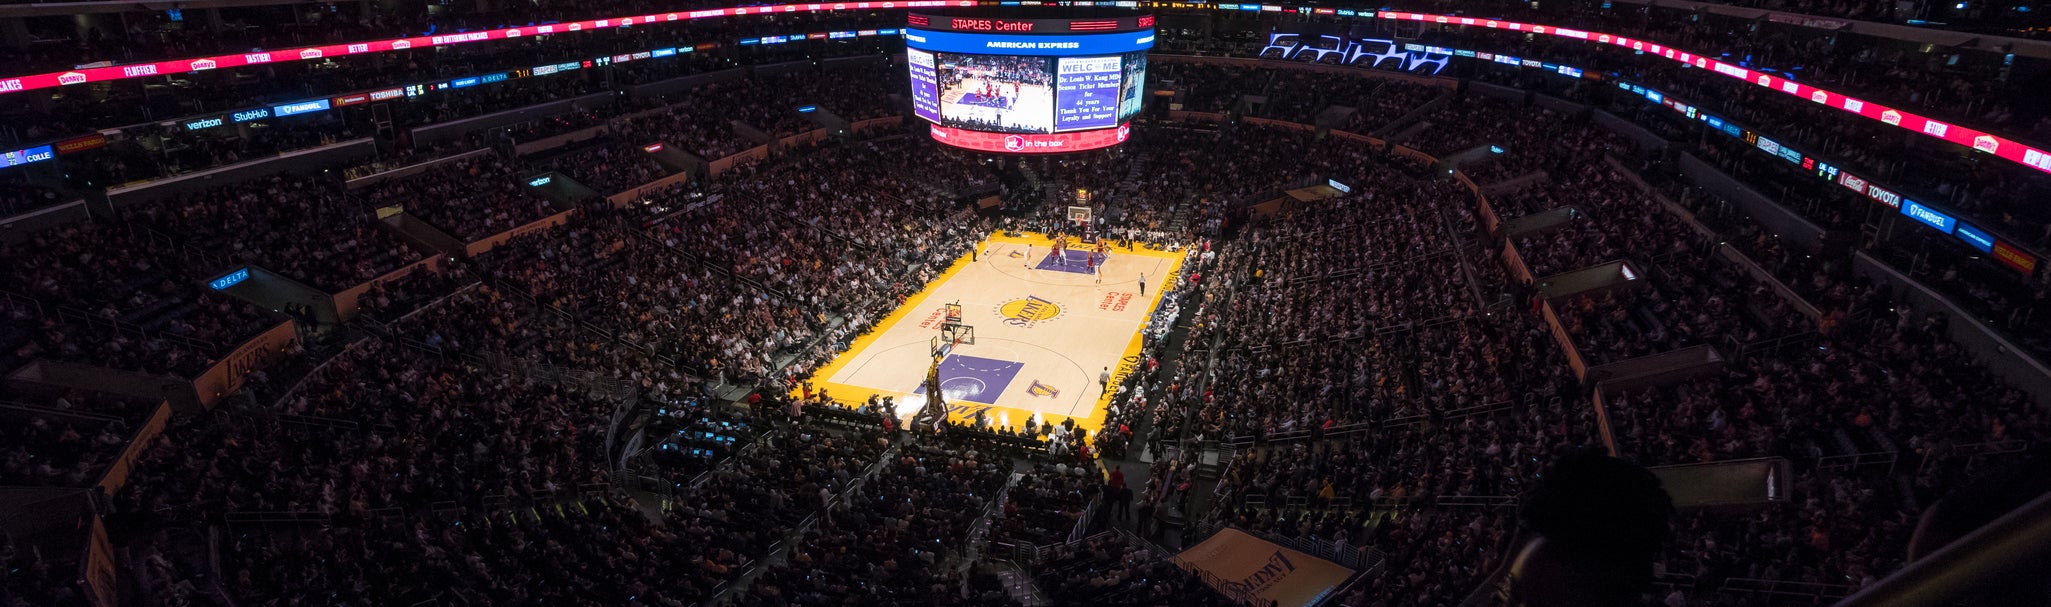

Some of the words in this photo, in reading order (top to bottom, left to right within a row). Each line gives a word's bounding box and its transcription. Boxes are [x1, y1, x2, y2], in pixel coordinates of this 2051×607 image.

[951, 18, 992, 31] STAPLES
[995, 20, 1034, 31] Center
[245, 53, 272, 64] TASTIER!
[632, 51, 651, 60] TOYOTA
[1062, 62, 1118, 72] WELCME
[1522, 59, 1542, 68] TOYOTA
[123, 64, 158, 77] FLUFFIER!
[487, 73, 508, 82] DELTA
[370, 89, 404, 100] TOSHIBA
[291, 103, 321, 112] FANDUEL
[233, 109, 268, 122] StubHub
[1093, 112, 1112, 120] Support
[187, 118, 222, 130] verizon
[27, 152, 51, 163] COLLE
[1868, 184, 1900, 208] TOYOTA
[1916, 208, 1945, 227] FANDUEL
[220, 270, 249, 288] DELTA
[1099, 291, 1119, 311] Center
[1002, 294, 1053, 327] LAKERS
[226, 342, 271, 390] LAKERS
